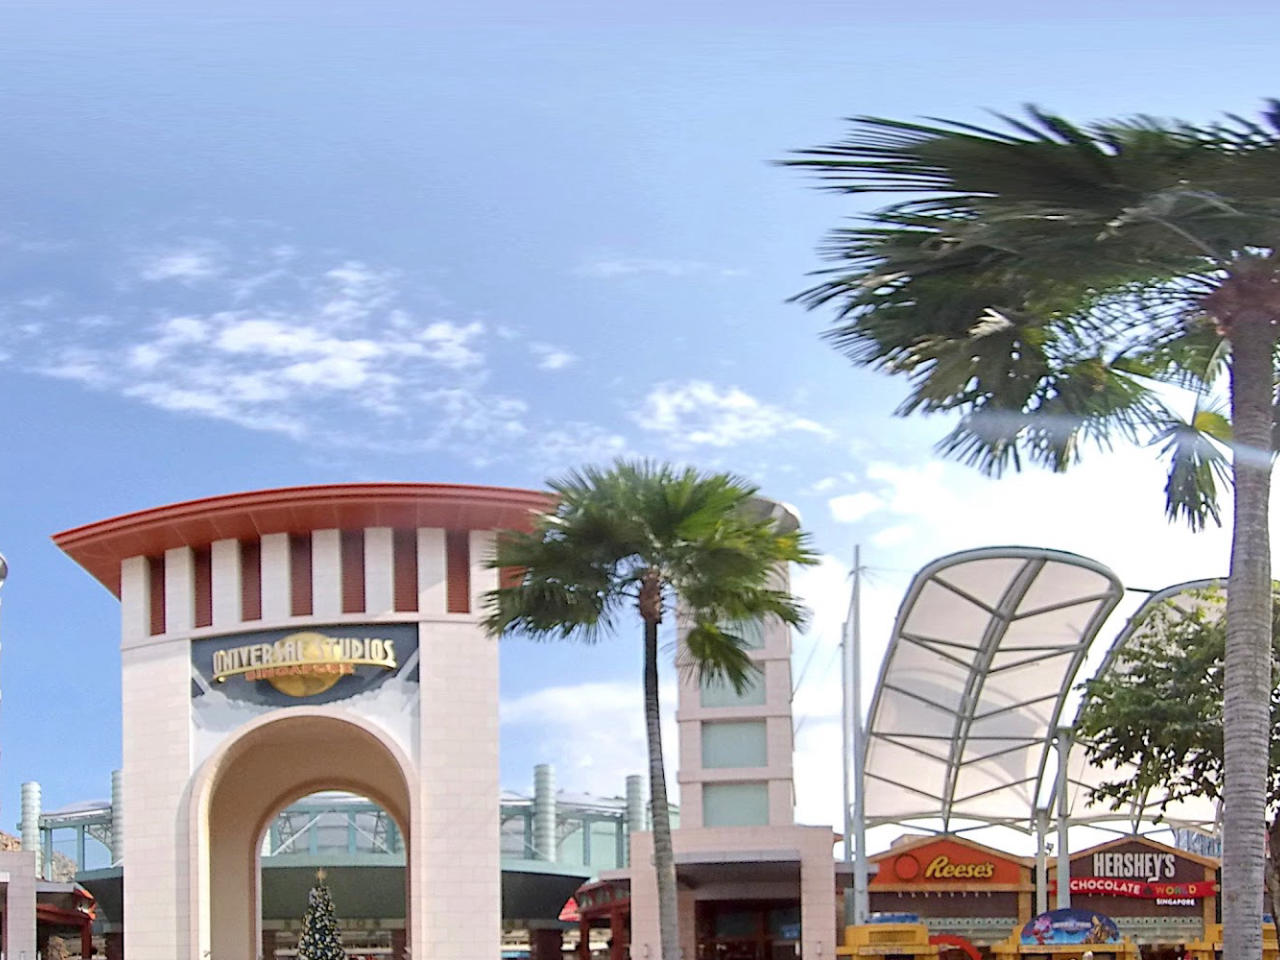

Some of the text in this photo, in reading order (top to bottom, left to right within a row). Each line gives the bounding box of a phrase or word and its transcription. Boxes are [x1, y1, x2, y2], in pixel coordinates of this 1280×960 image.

[213, 637, 395, 674] UNIVERSAL STUDIOS
[925, 856, 994, 878] Reese's
[1093, 853, 1176, 883] HERSHEY'S
[1070, 879, 1141, 894] CHOCOLATE
[1156, 898, 1196, 906] SINGAPORE
